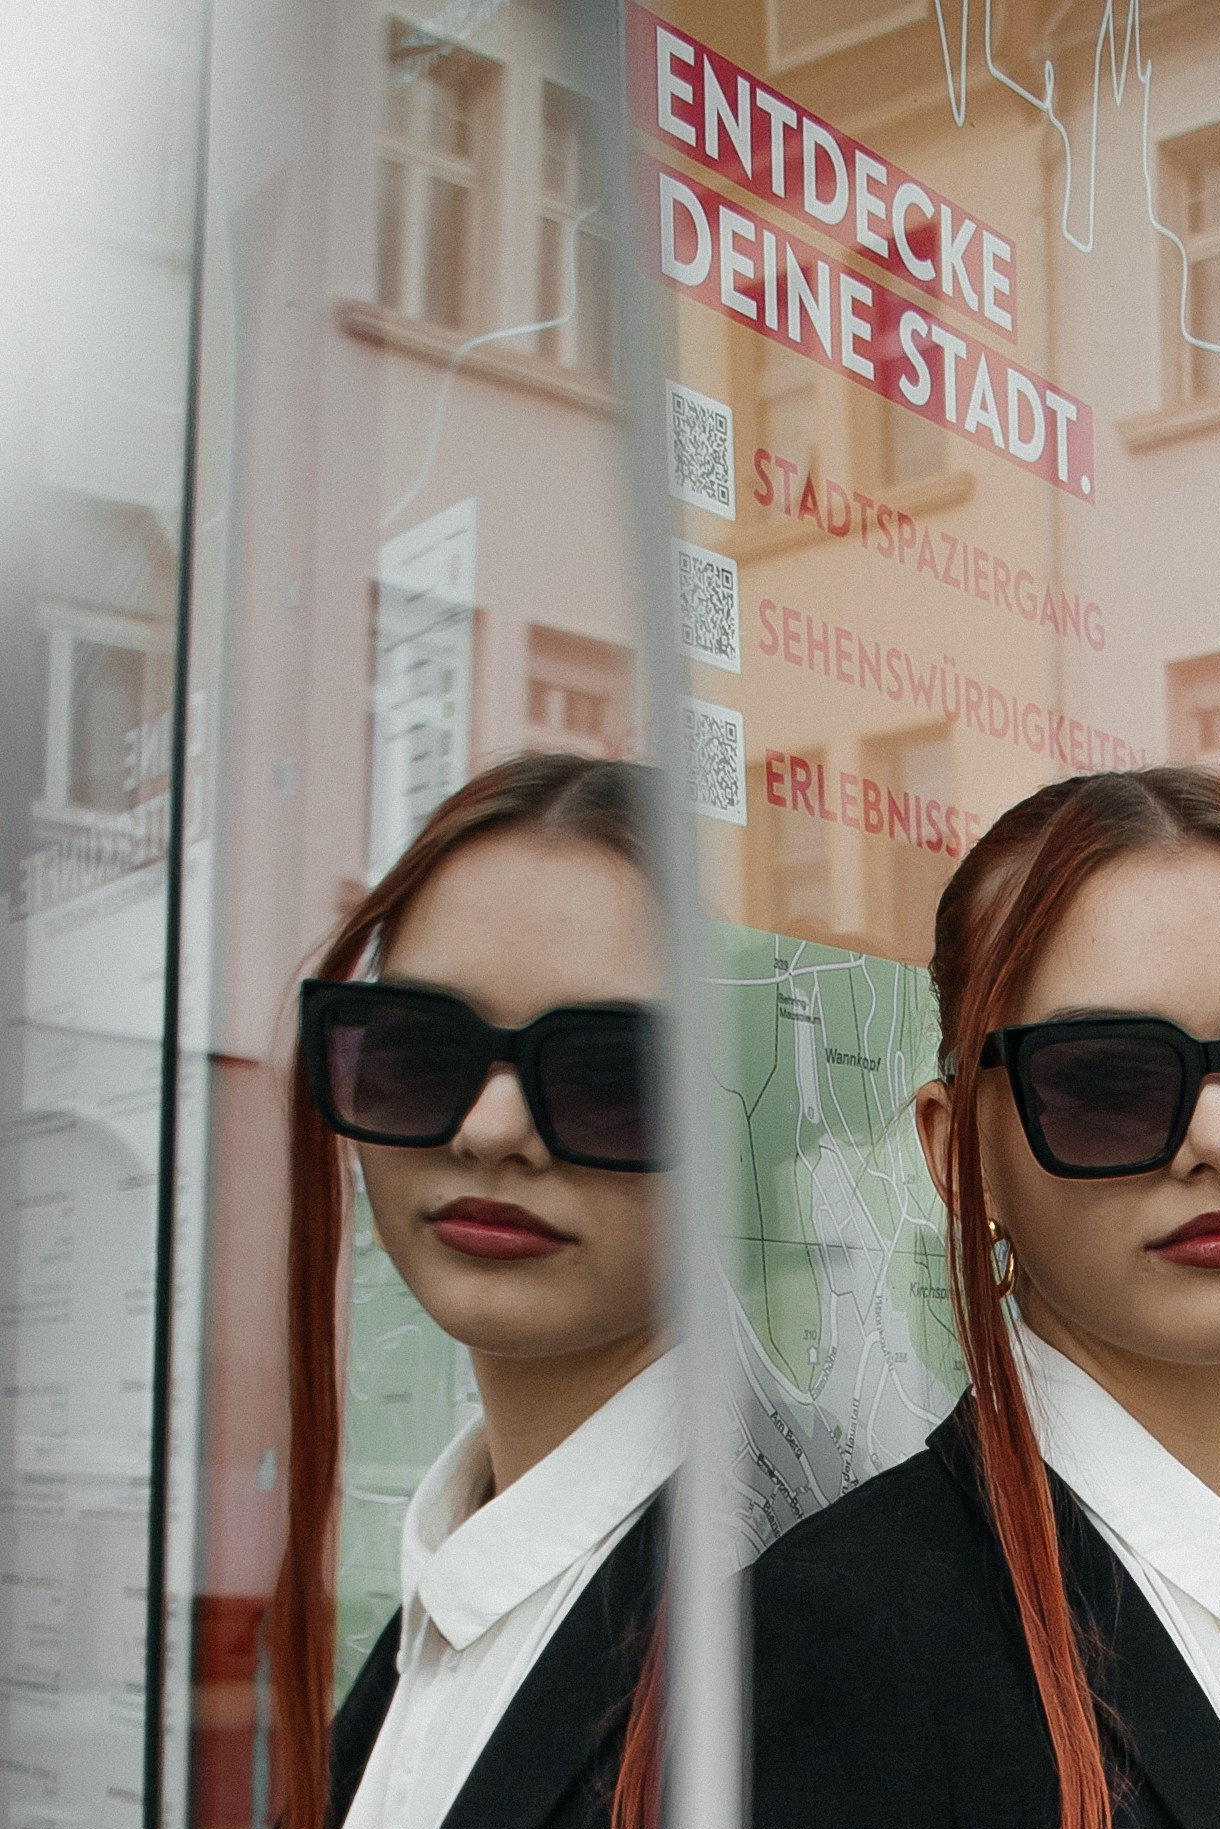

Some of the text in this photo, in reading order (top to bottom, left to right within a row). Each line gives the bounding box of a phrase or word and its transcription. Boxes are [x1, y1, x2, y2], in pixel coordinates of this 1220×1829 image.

[656, 25, 1013, 333] ENTDECKE
[659, 172, 1092, 495] DEINE STADT.
[753, 447, 1106, 652] STADTSPAZIERGANG
[825, 1048, 881, 1072] Wannkopf
[769, 1410, 785, 1435] Am
[841, 1460, 852, 1482] der
